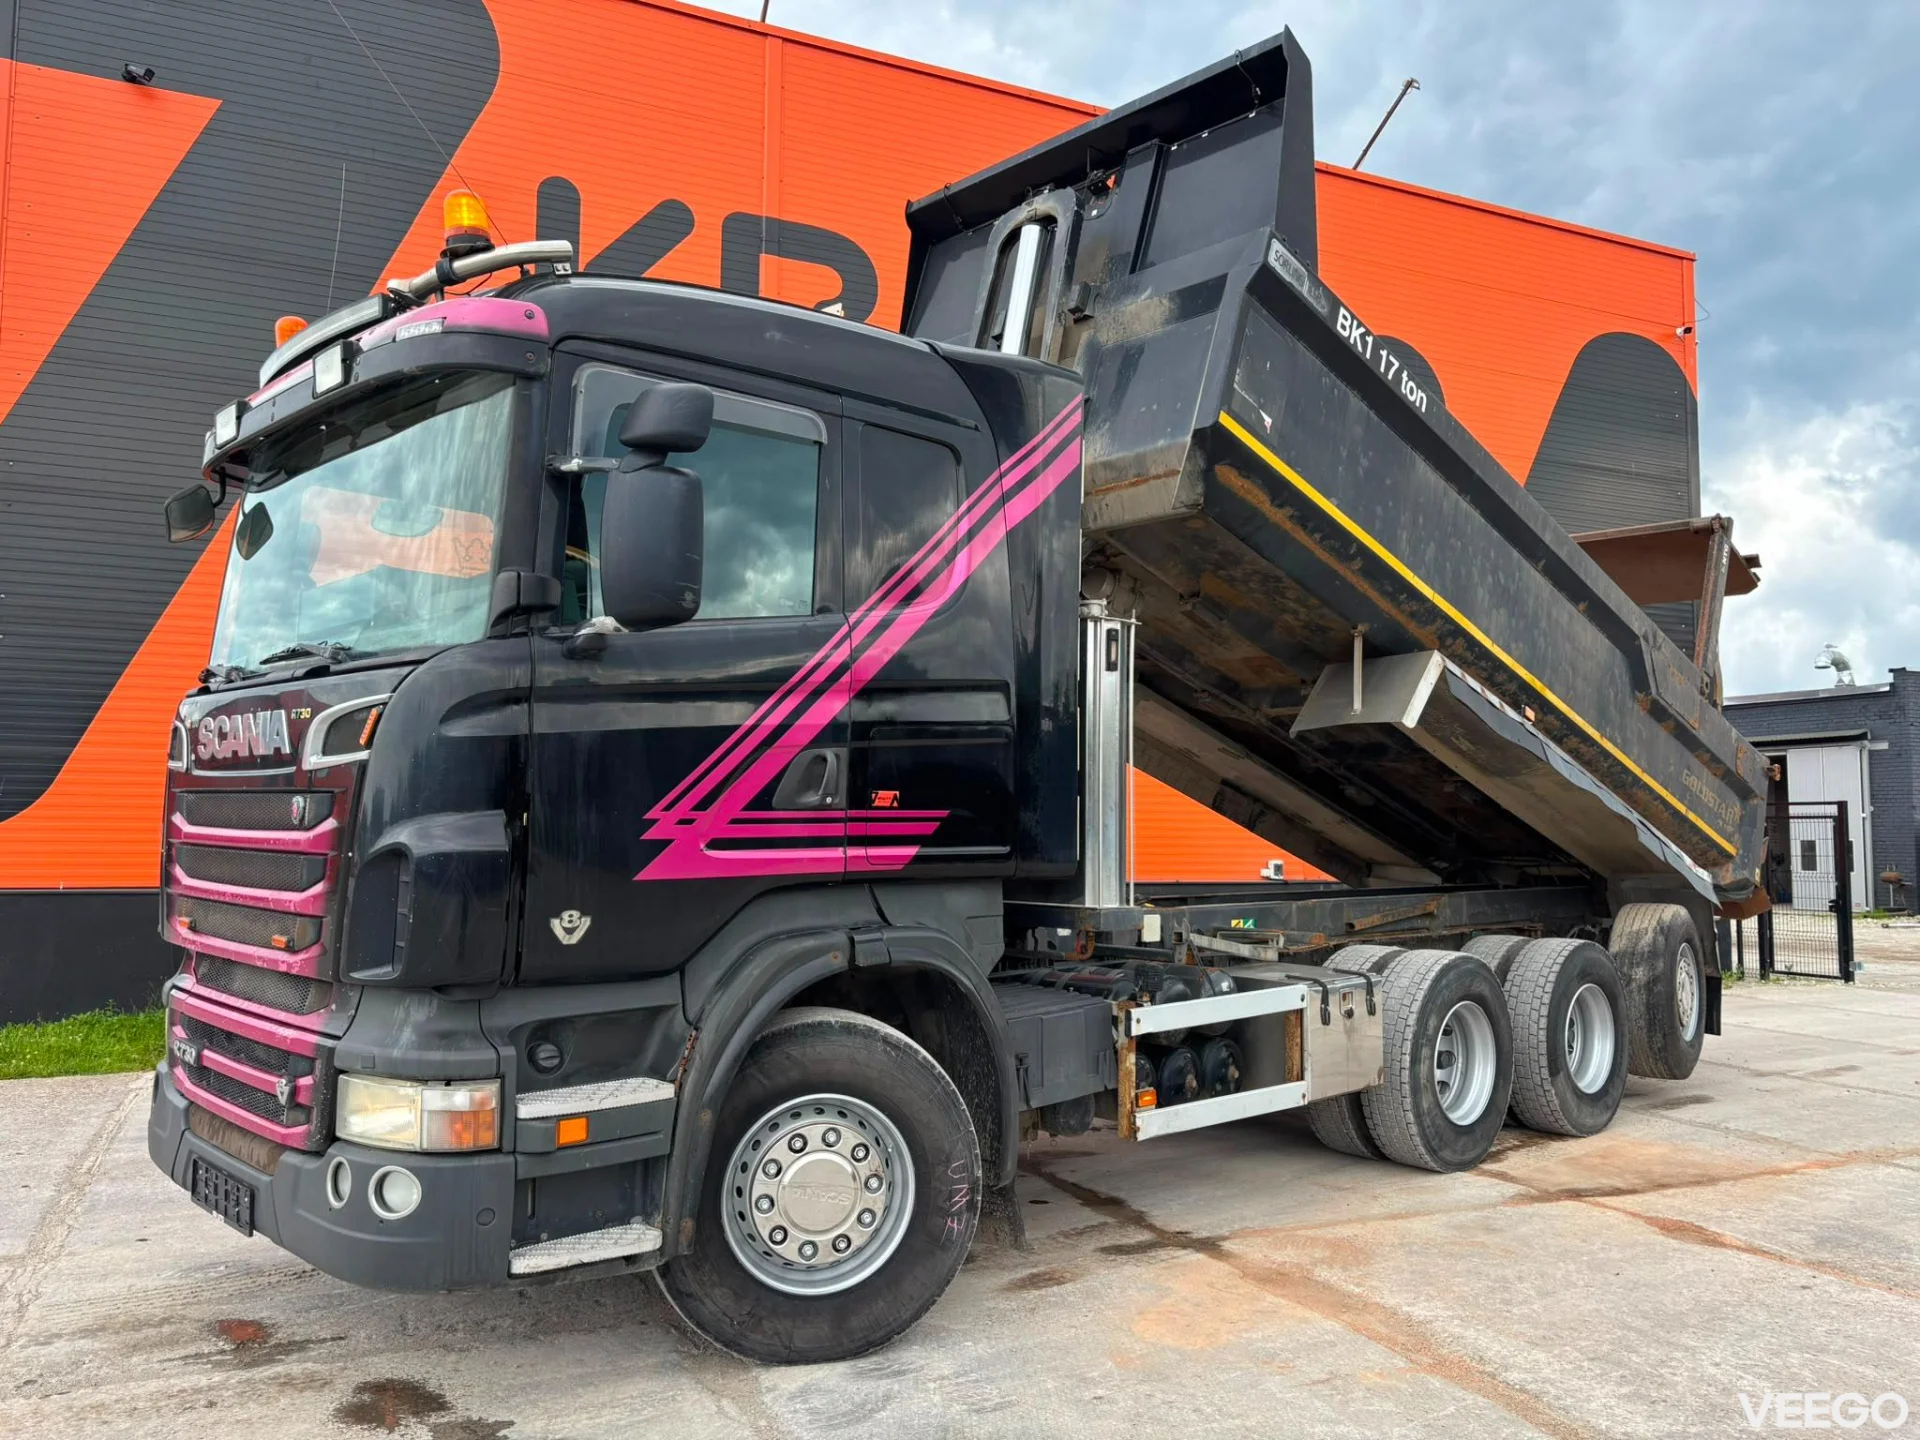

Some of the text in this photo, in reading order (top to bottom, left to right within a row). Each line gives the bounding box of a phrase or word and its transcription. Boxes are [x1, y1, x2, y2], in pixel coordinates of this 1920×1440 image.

[1336, 305, 1428, 413] BK1 17 ton
[197, 708, 292, 760] SCANIA
[290, 707, 312, 720] R730
